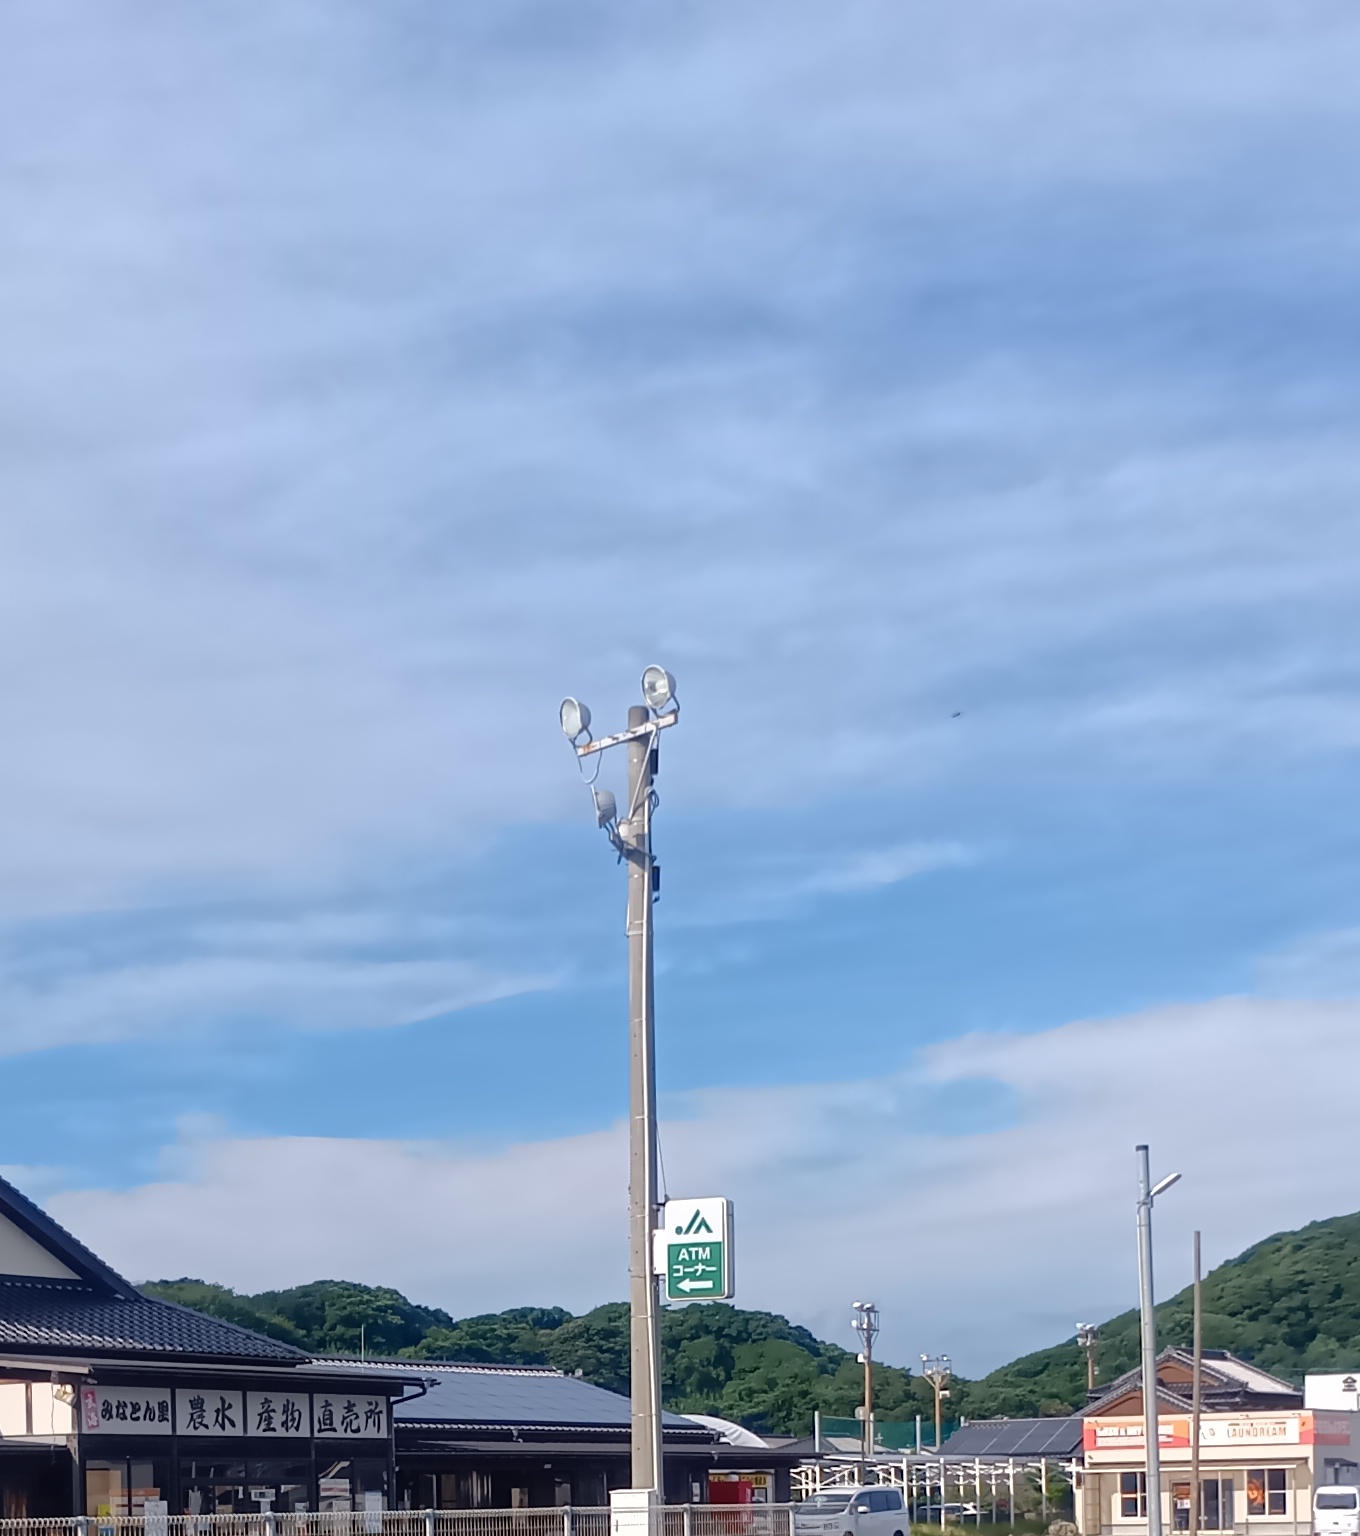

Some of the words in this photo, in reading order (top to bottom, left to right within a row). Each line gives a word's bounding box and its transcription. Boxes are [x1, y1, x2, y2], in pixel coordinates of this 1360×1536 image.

[678, 1246, 711, 1261] ATM
[672, 1262, 718, 1277] コーナー
[101, 1399, 169, 1423] みなとん里
[186, 1395, 383, 1434] 農水産物直売所
